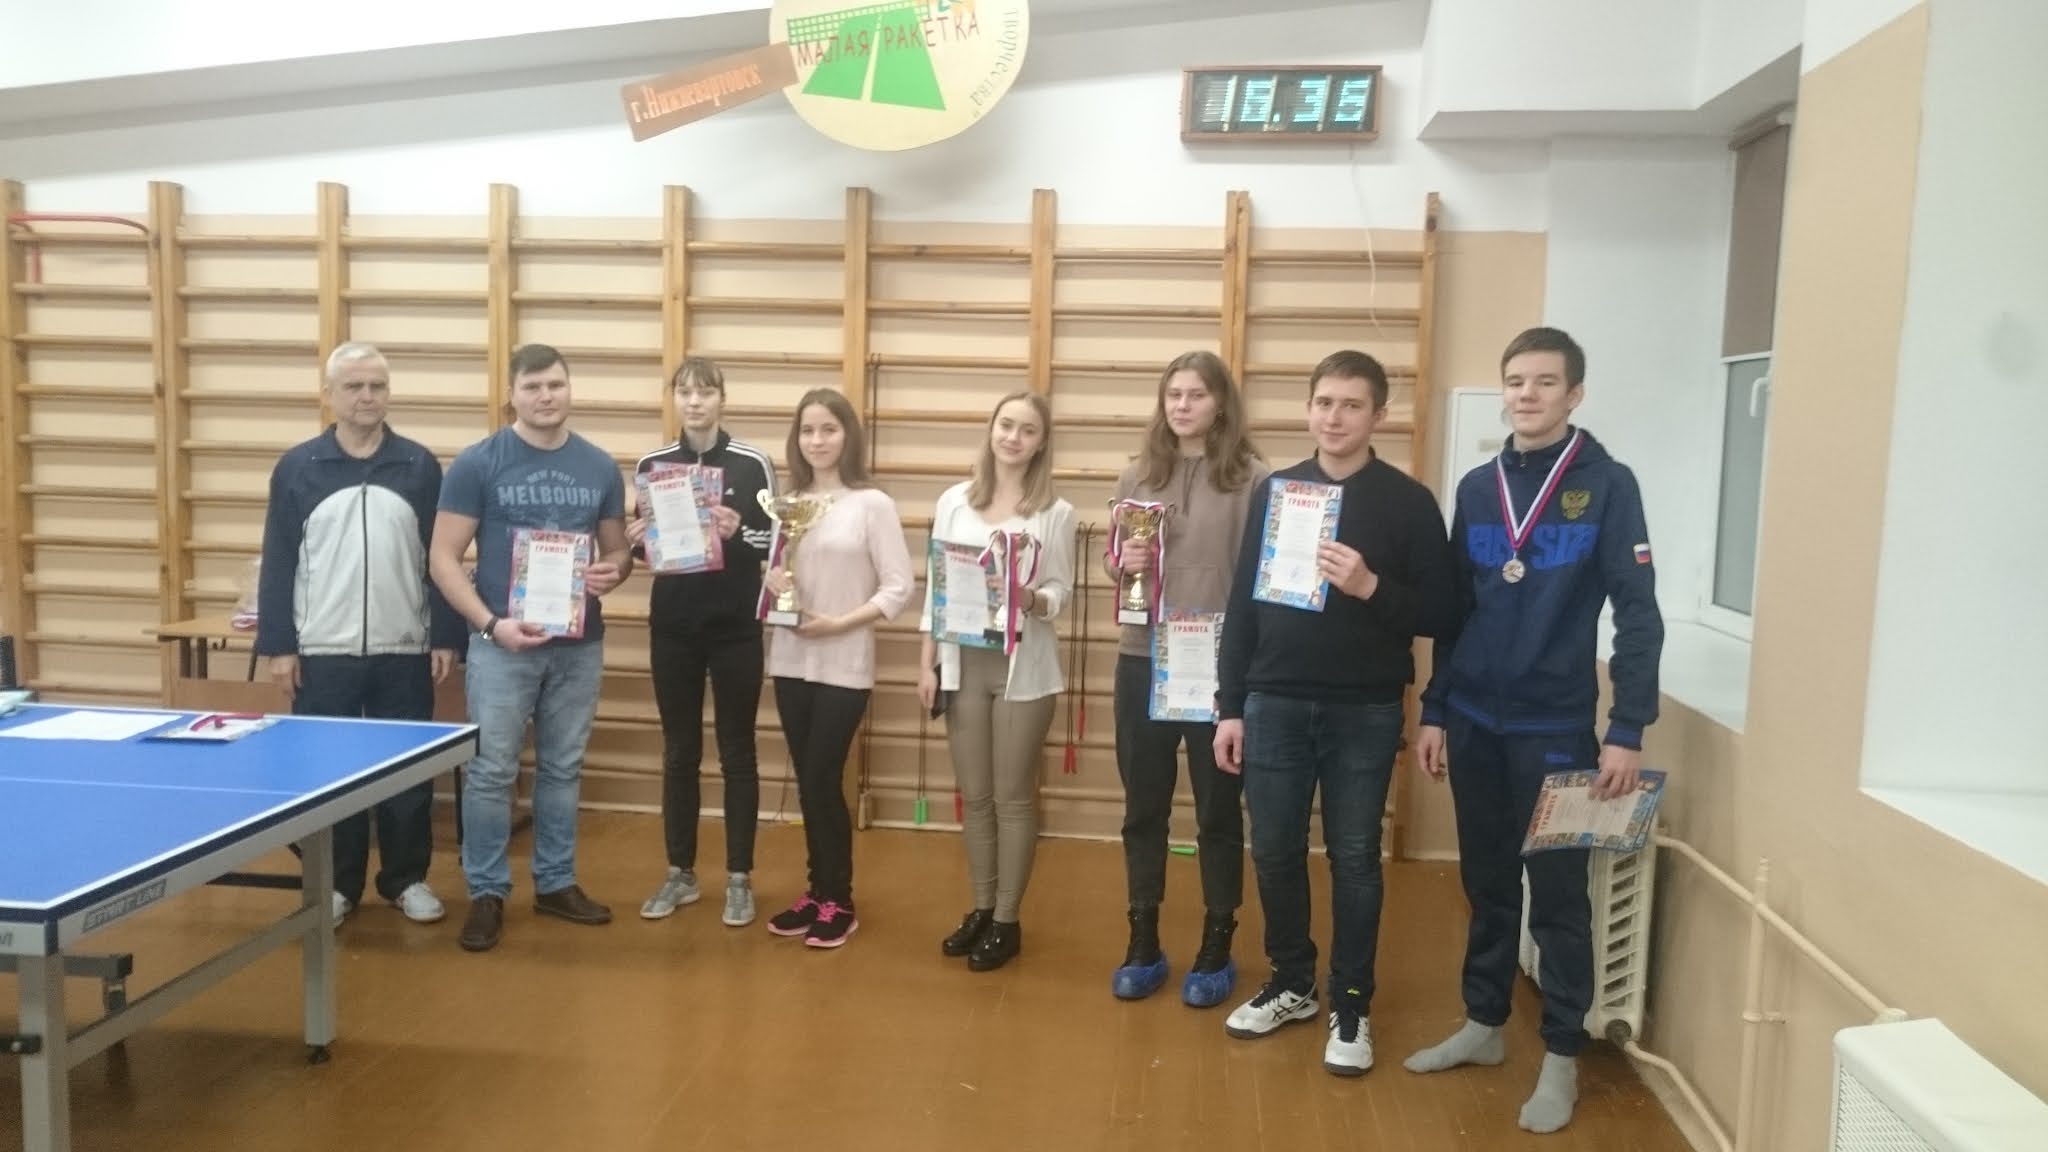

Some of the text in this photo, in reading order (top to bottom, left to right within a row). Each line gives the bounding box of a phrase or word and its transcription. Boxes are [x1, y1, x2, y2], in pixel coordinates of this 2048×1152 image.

[797, 10, 980, 67] МАЛАЯ РАКЕТКА
[497, 484, 602, 507] MELBOURN
[1287, 497, 1320, 510] ГРАМОТА
[535, 545, 569, 554] ГРАМОТА
[1467, 523, 1599, 570] RUSIA
[1173, 625, 1209, 633] ГРАМОТА
